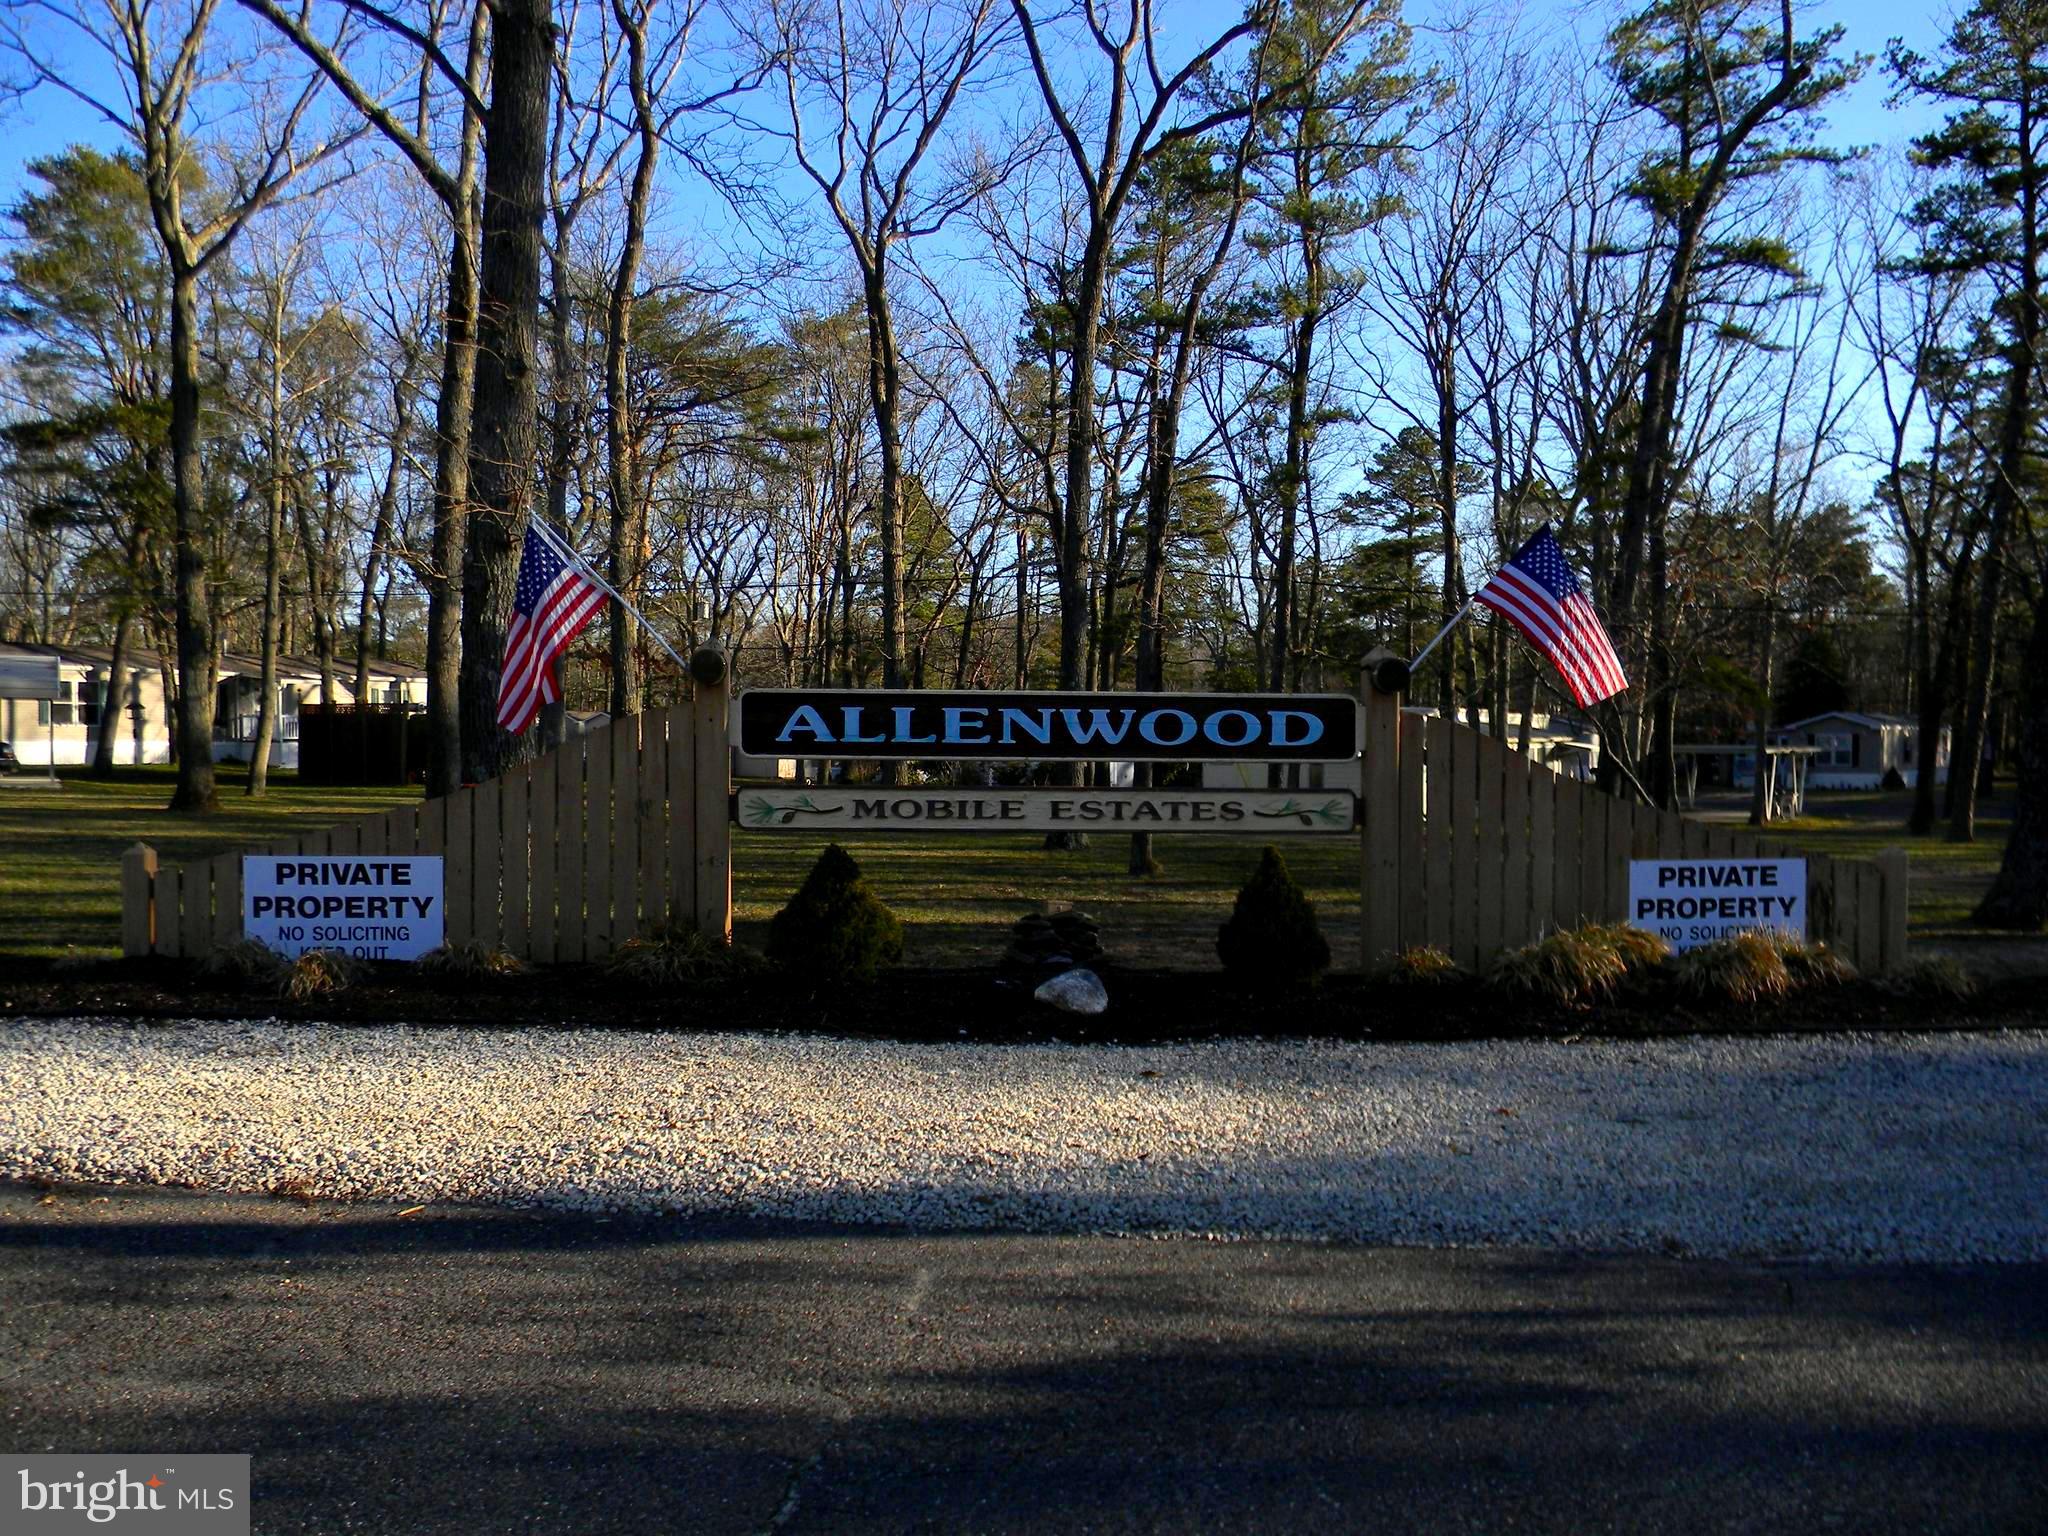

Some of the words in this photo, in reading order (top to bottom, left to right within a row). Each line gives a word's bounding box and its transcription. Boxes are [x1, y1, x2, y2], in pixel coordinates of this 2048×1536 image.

[775, 704, 1325, 746] ALLENWOOD
[851, 799, 1026, 820] MOBILE
[1049, 800, 1246, 822] ESTATES
[276, 862, 412, 886] PRIVATE
[1658, 865, 1778, 888] PRIVATE
[253, 895, 435, 919] PROPERTY
[1637, 896, 1798, 920] PROPERTY
[278, 926, 305, 941] NO
[312, 926, 411, 941] SOLICITING
[1659, 926, 1683, 941] NO
[352, 946, 389, 960] OUT
